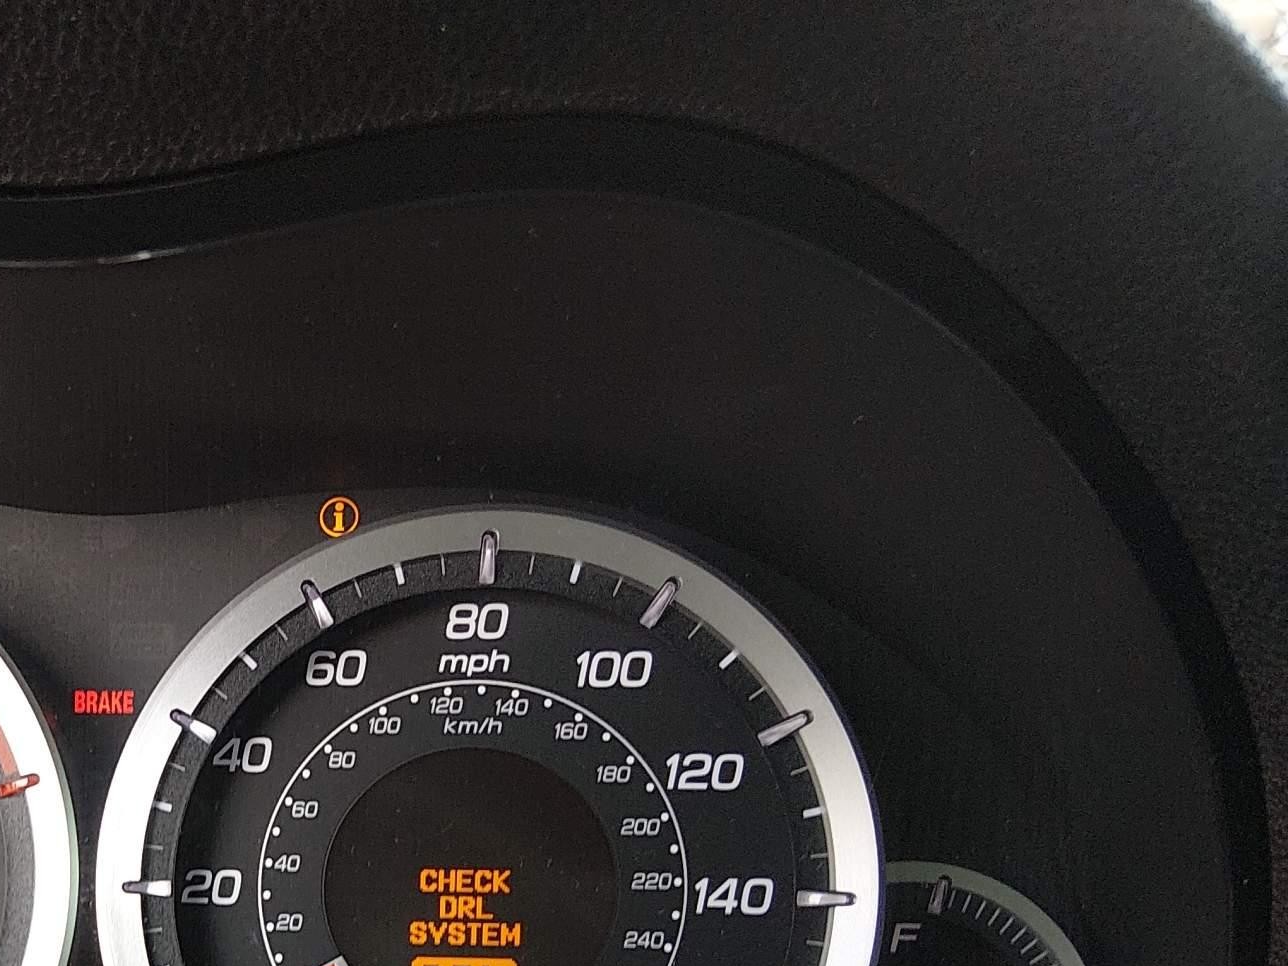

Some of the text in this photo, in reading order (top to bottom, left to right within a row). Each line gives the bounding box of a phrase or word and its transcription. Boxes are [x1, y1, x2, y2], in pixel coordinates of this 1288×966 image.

[445, 603, 509, 640] 80
[306, 649, 367, 686] 60
[438, 649, 510, 678] mph
[576, 650, 653, 688] 100
[75, 691, 134, 713] BRAKE
[430, 697, 464, 714] 120
[496, 698, 529, 716] 140
[369, 716, 401, 734] 100
[443, 717, 503, 734] km/h
[555, 722, 588, 740] 160
[212, 736, 273, 773] 40
[327, 751, 356, 768] 80
[597, 766, 632, 783] 180
[666, 753, 744, 790] 120
[291, 801, 319, 818] 60
[620, 818, 661, 836] 200
[274, 854, 301, 872] 40
[180, 869, 242, 905] 20
[420, 869, 510, 893] CHECK
[631, 872, 673, 890] 220
[695, 877, 774, 915] 140
[439, 896, 493, 919] DRL
[275, 913, 303, 931] 20
[410, 921, 521, 946] SYSTEM
[623, 931, 664, 949] 240
[889, 921, 922, 954] F
